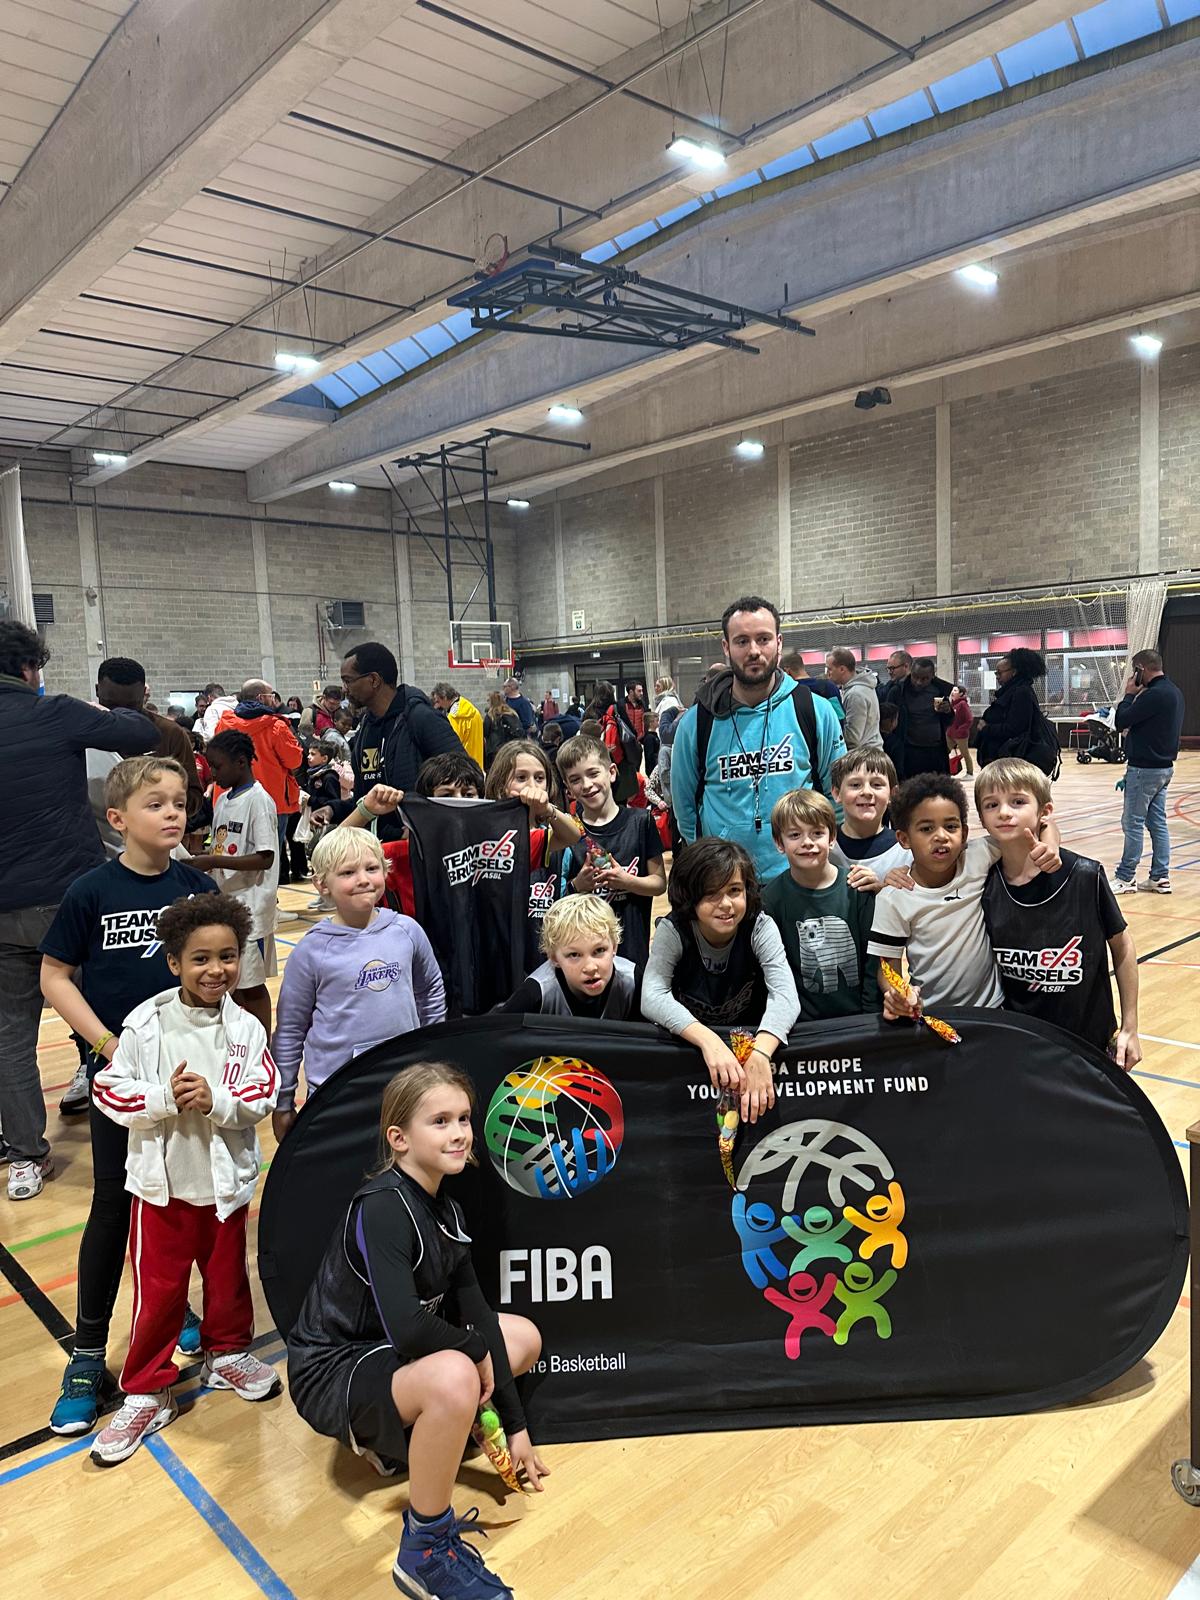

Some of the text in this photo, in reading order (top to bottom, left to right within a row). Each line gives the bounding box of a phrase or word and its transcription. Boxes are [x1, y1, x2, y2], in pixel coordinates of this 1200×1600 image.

[719, 752, 761, 769] TEAM
[721, 760, 793, 780] BRUSSELS
[444, 846, 480, 870] TEAM
[449, 858, 512, 883] BRUSSELS
[482, 872, 502, 880] ASBL
[104, 912, 159, 931] TEAM
[105, 928, 156, 946] BRUS
[355, 966, 400, 990] LAKERS
[1041, 985, 1066, 993] ASBL
[797, 1057, 862, 1076] EUROPE
[687, 1076, 929, 1100] YOU VELOPMENT FUND
[499, 1245, 613, 1305] FIBA
[529, 1351, 626, 1375] re Basketball
